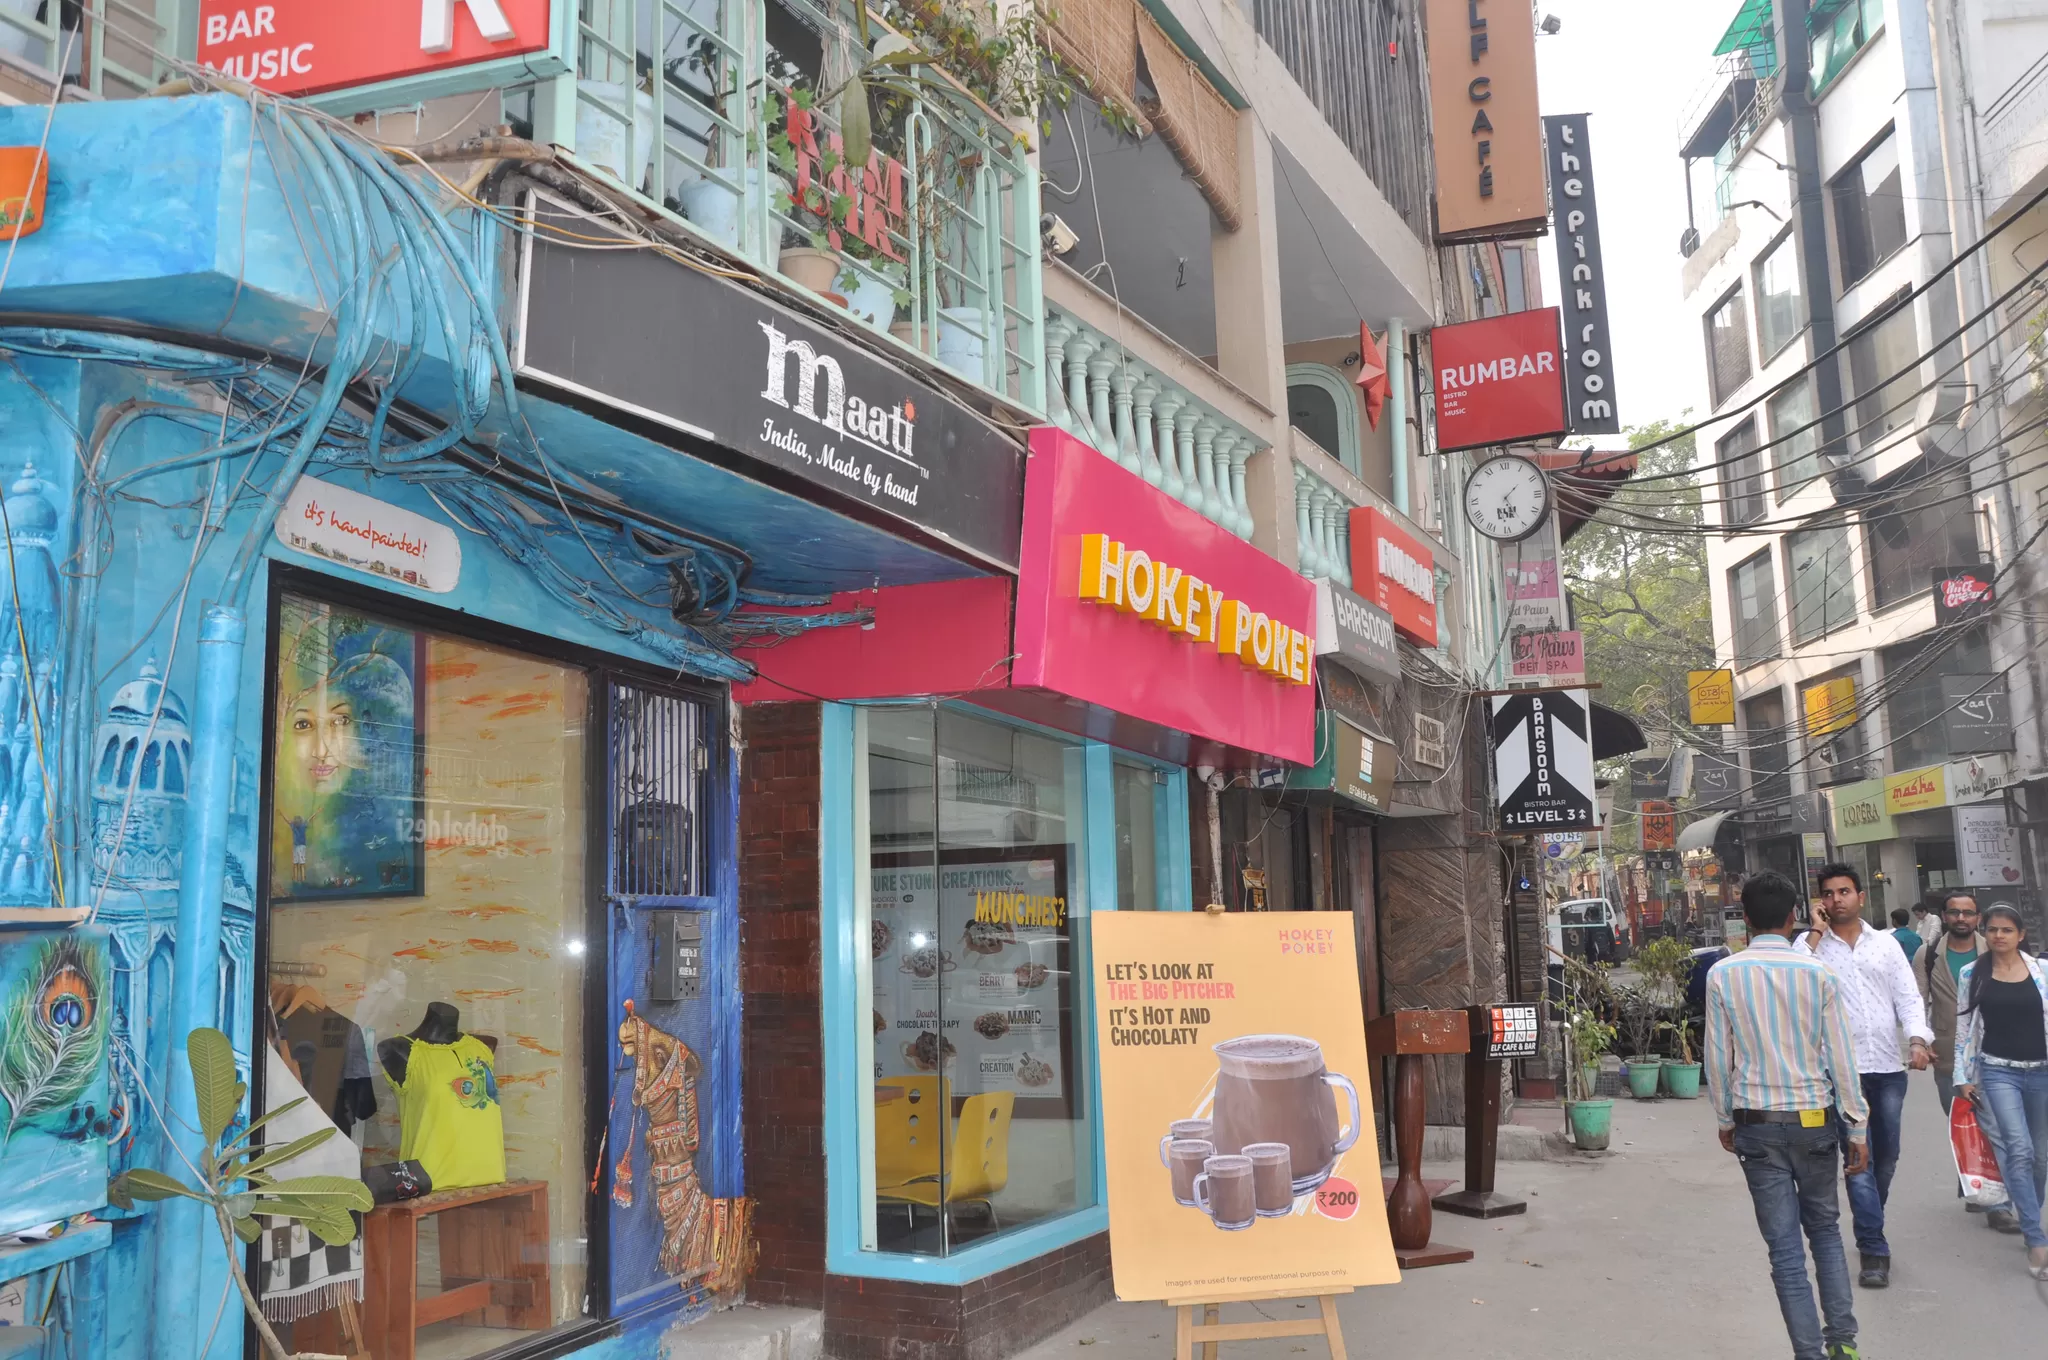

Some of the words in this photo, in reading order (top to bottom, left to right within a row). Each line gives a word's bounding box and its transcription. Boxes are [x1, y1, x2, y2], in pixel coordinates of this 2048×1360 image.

[206, 6, 276, 46] BAR
[204, 43, 314, 84] MUSIC
[1560, 124, 1584, 198] the
[1567, 209, 1594, 311] pink
[1441, 351, 1555, 390] RUMBAR
[1581, 323, 1612, 421] room
[757, 316, 920, 457] maati
[1443, 390, 1468, 400] BISTRO
[1444, 407, 1467, 417] MUSIC
[759, 417, 812, 465] India,
[816, 443, 861, 482] Made
[863, 465, 882, 497] by
[884, 480, 919, 506] hand
[1082, 533, 1224, 643] HOKEY
[1221, 600, 1316, 686] POKEY
[1335, 591, 1396, 653] BARSOOM
[1546, 660, 1569, 671] SPA
[1532, 697, 1552, 796] BARSOOM
[1524, 799, 1550, 808] BISTRO
[1551, 799, 1567, 807] BAR
[1517, 810, 1563, 823] LEVEL
[1567, 808, 1576, 820] 3
[1543, 831, 1583, 843] ROLL
[1966, 838, 2012, 853] LITTLE
[974, 889, 1066, 927] MUNCHIES?
[1279, 928, 1334, 942] HOKEY
[1281, 942, 1334, 954] POKEY
[1106, 961, 1148, 981] LET'S
[1152, 963, 1192, 981] LOOK
[1196, 963, 1214, 980] AT
[896, 1020, 931, 1029] CHOCOLATE
[1109, 1006, 1139, 1026] IT'S
[1179, 1007, 1211, 1025] AND
[1490, 1044, 1502, 1052] ELF
[1502, 1043, 1518, 1051] CAFE
[1524, 1042, 1536, 1051] BAR
[979, 1062, 1014, 1073] CREATION
[1318, 1190, 1358, 1208] ₹200
[1165, 1279, 1192, 1288] Images
[1207, 1276, 1226, 1285] used
[1227, 1275, 1237, 1284] for
[1239, 1271, 1299, 1284] representational
[1299, 1269, 1330, 1279] purpose
[1331, 1268, 1349, 1277] only.
